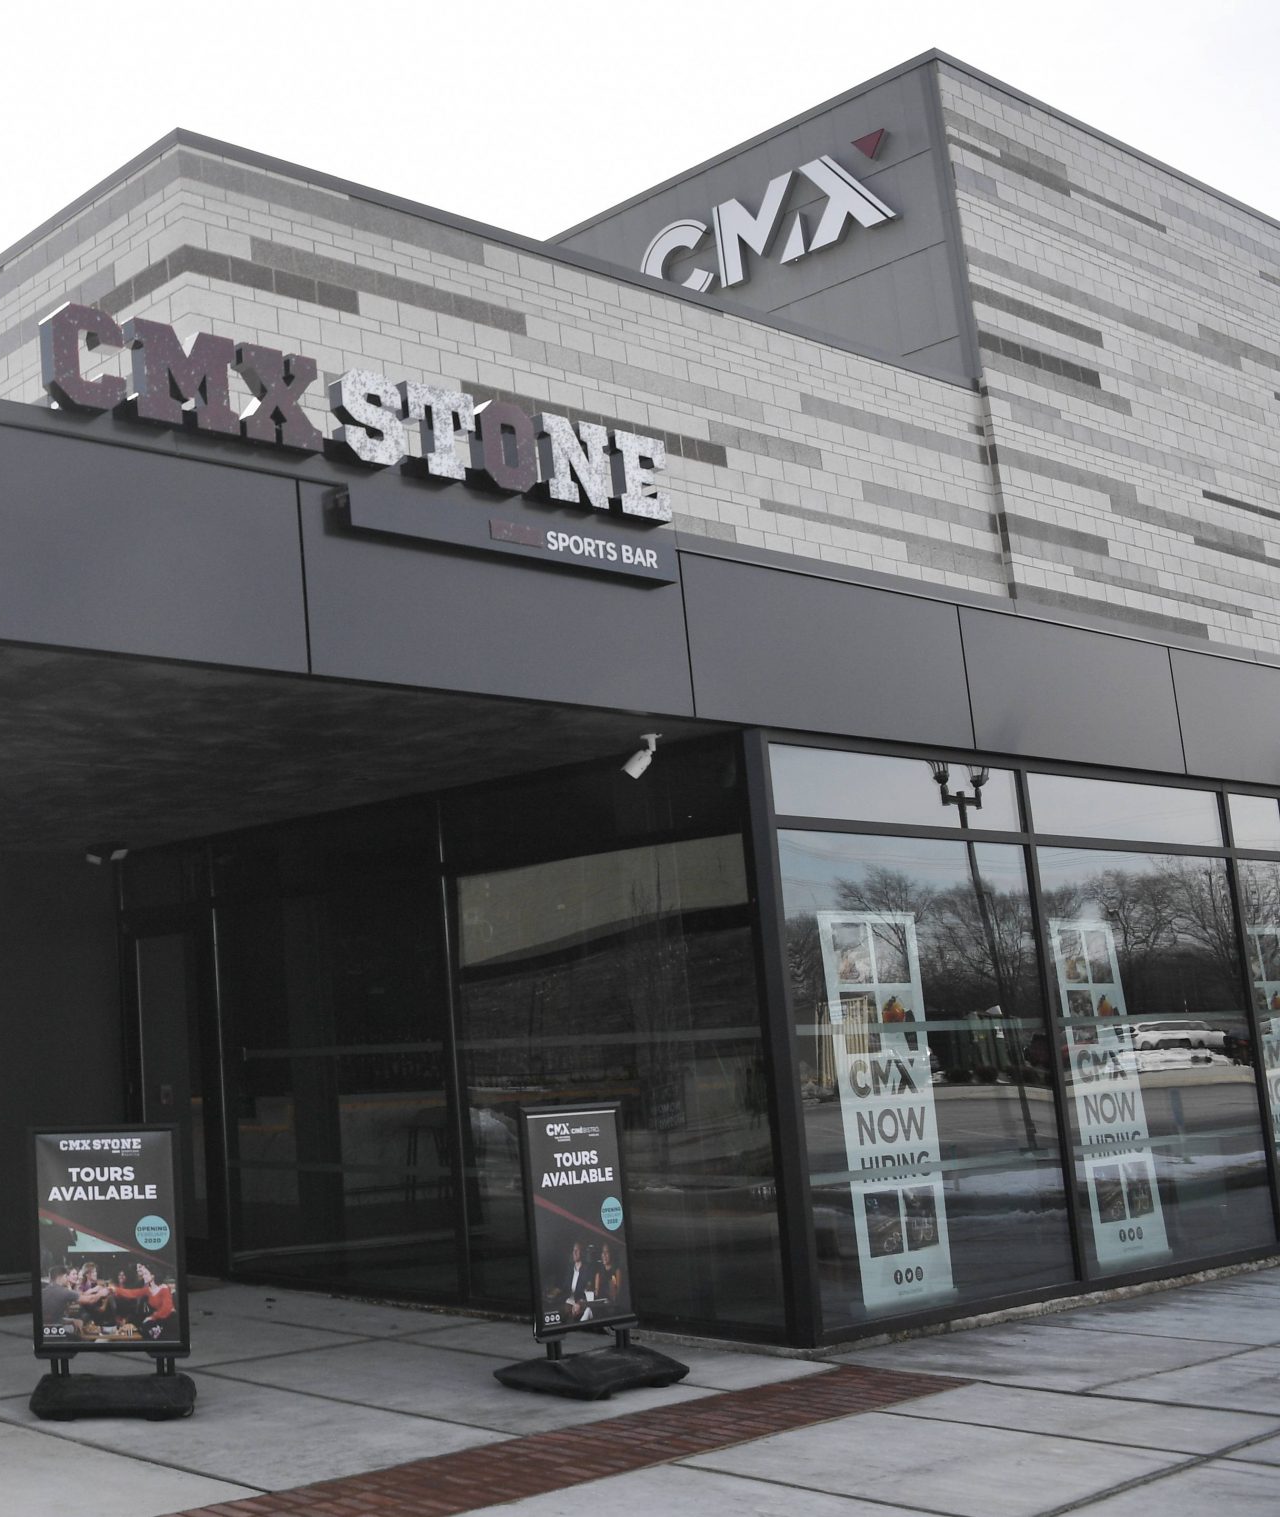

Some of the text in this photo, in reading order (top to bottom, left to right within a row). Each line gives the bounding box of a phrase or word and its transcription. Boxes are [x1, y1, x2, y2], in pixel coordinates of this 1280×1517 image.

[640, 154, 897, 293] CMX
[39, 302, 672, 525] CMX STONE
[546, 530, 658, 569] SPORTS BAR
[849, 1058, 919, 1098] CMX
[1076, 1049, 1127, 1083] CMX
[1083, 1091, 1136, 1126] NOW
[546, 1123, 570, 1136] CMX
[856, 1106, 926, 1146] NOW
[60, 1138, 142, 1151] CMX STONE
[554, 1150, 598, 1168] TOURS
[68, 1166, 135, 1182] TOURS
[541, 1167, 614, 1188] AVAILABLE
[48, 1184, 158, 1201] AVAILABLE
